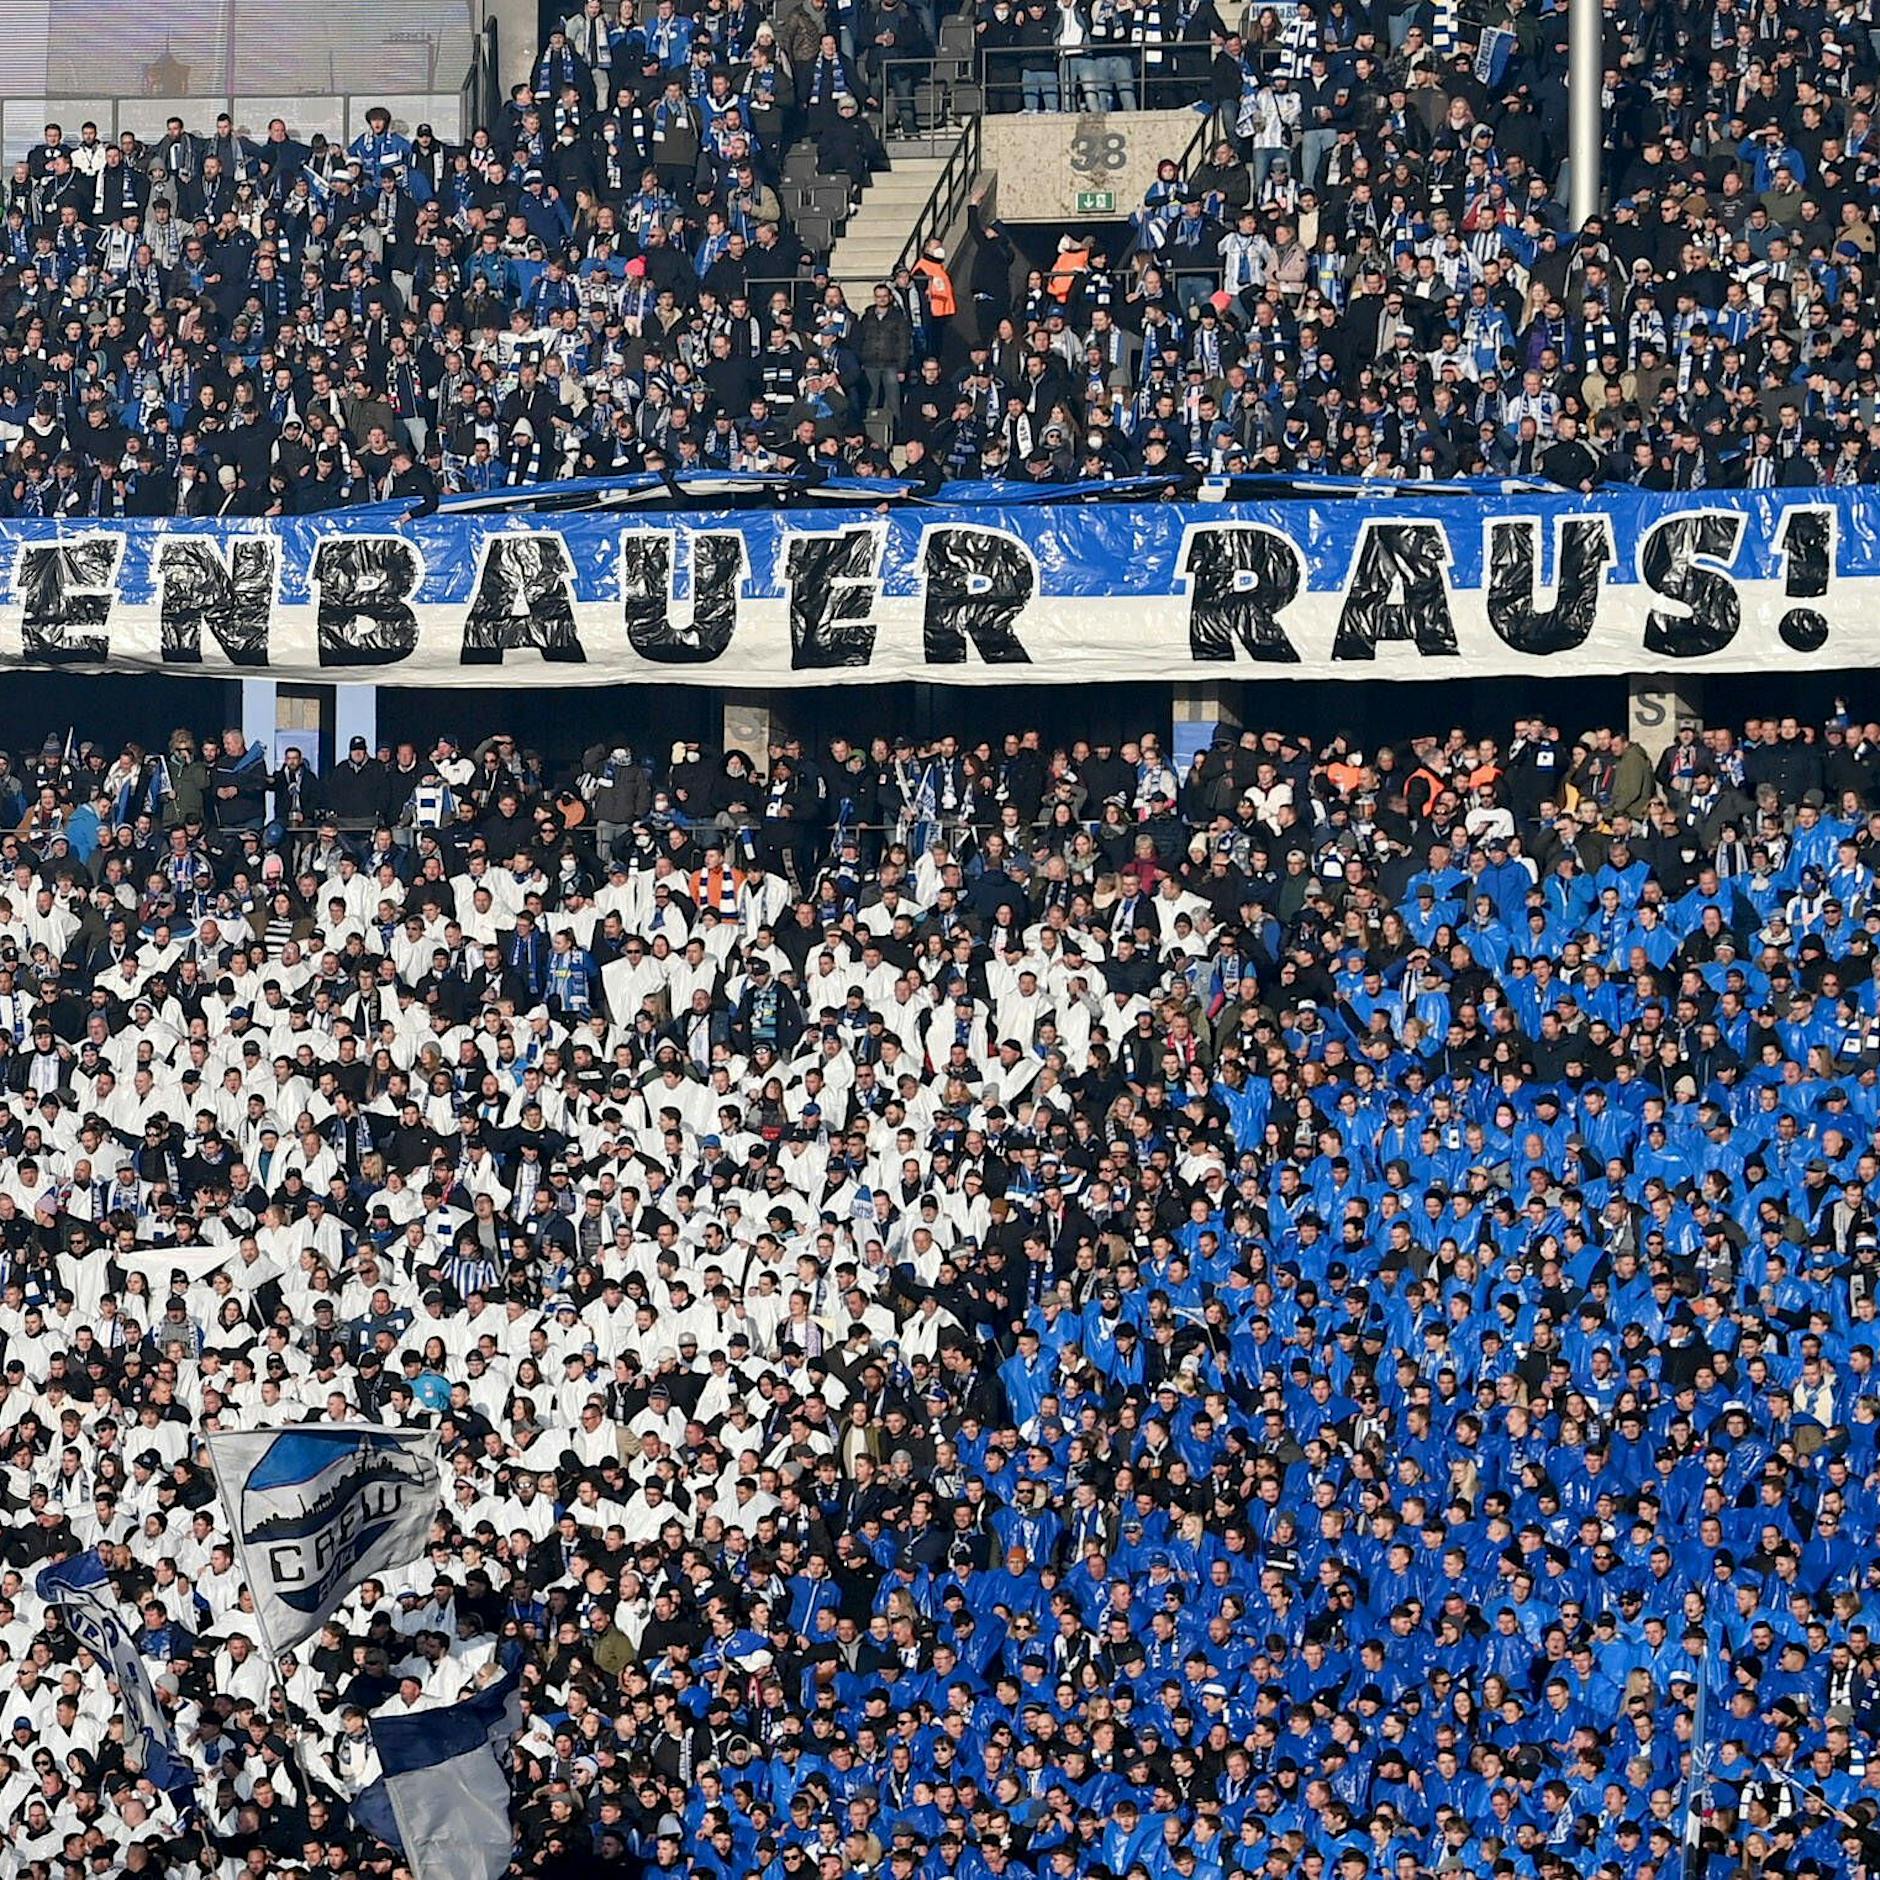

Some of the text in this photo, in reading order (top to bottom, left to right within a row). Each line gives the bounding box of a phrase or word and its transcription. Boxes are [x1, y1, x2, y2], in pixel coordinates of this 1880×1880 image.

[1071, 133, 1126, 171] 38
[16, 507, 1836, 670] ENBAUER RAUS!
[1634, 688, 1667, 727] S
[269, 1485, 402, 1583] CREW
